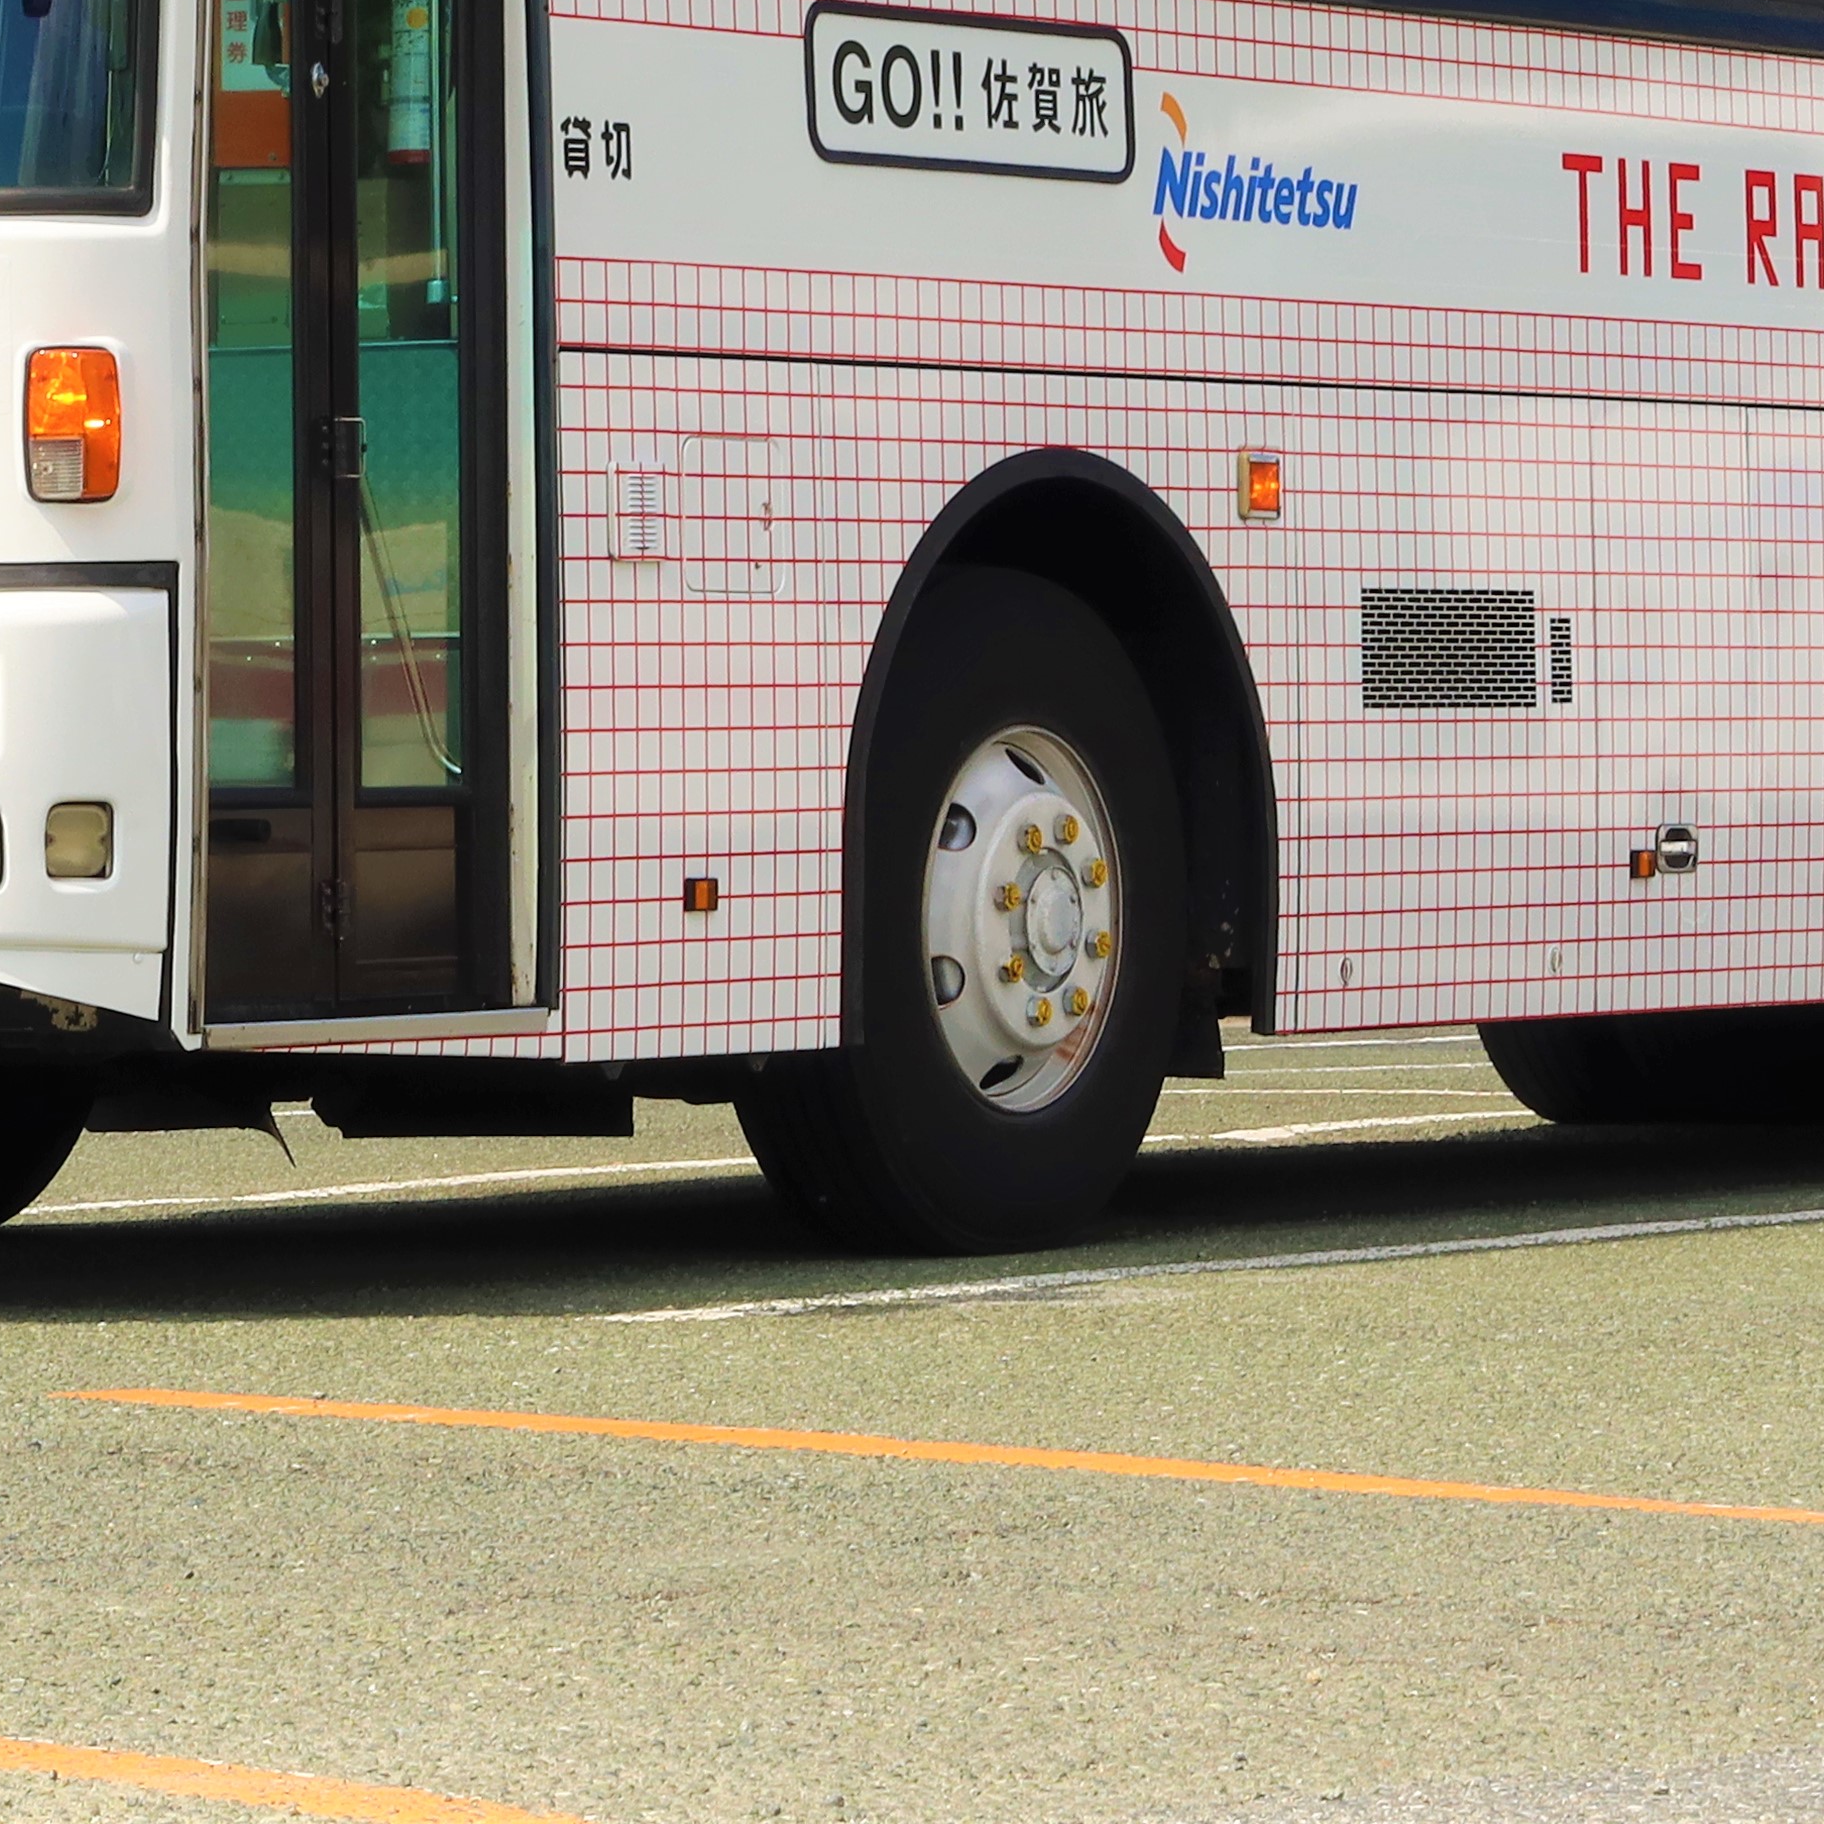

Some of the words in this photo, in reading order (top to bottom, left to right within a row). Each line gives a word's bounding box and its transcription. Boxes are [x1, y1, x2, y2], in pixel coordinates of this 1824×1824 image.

[830, 38, 966, 132] GO!!
[980, 56, 1110, 139] 佐賀旅
[559, 114, 634, 182] 貸切
[1152, 146, 1358, 231] Nishitetsu
[1561, 152, 1704, 282] THE
